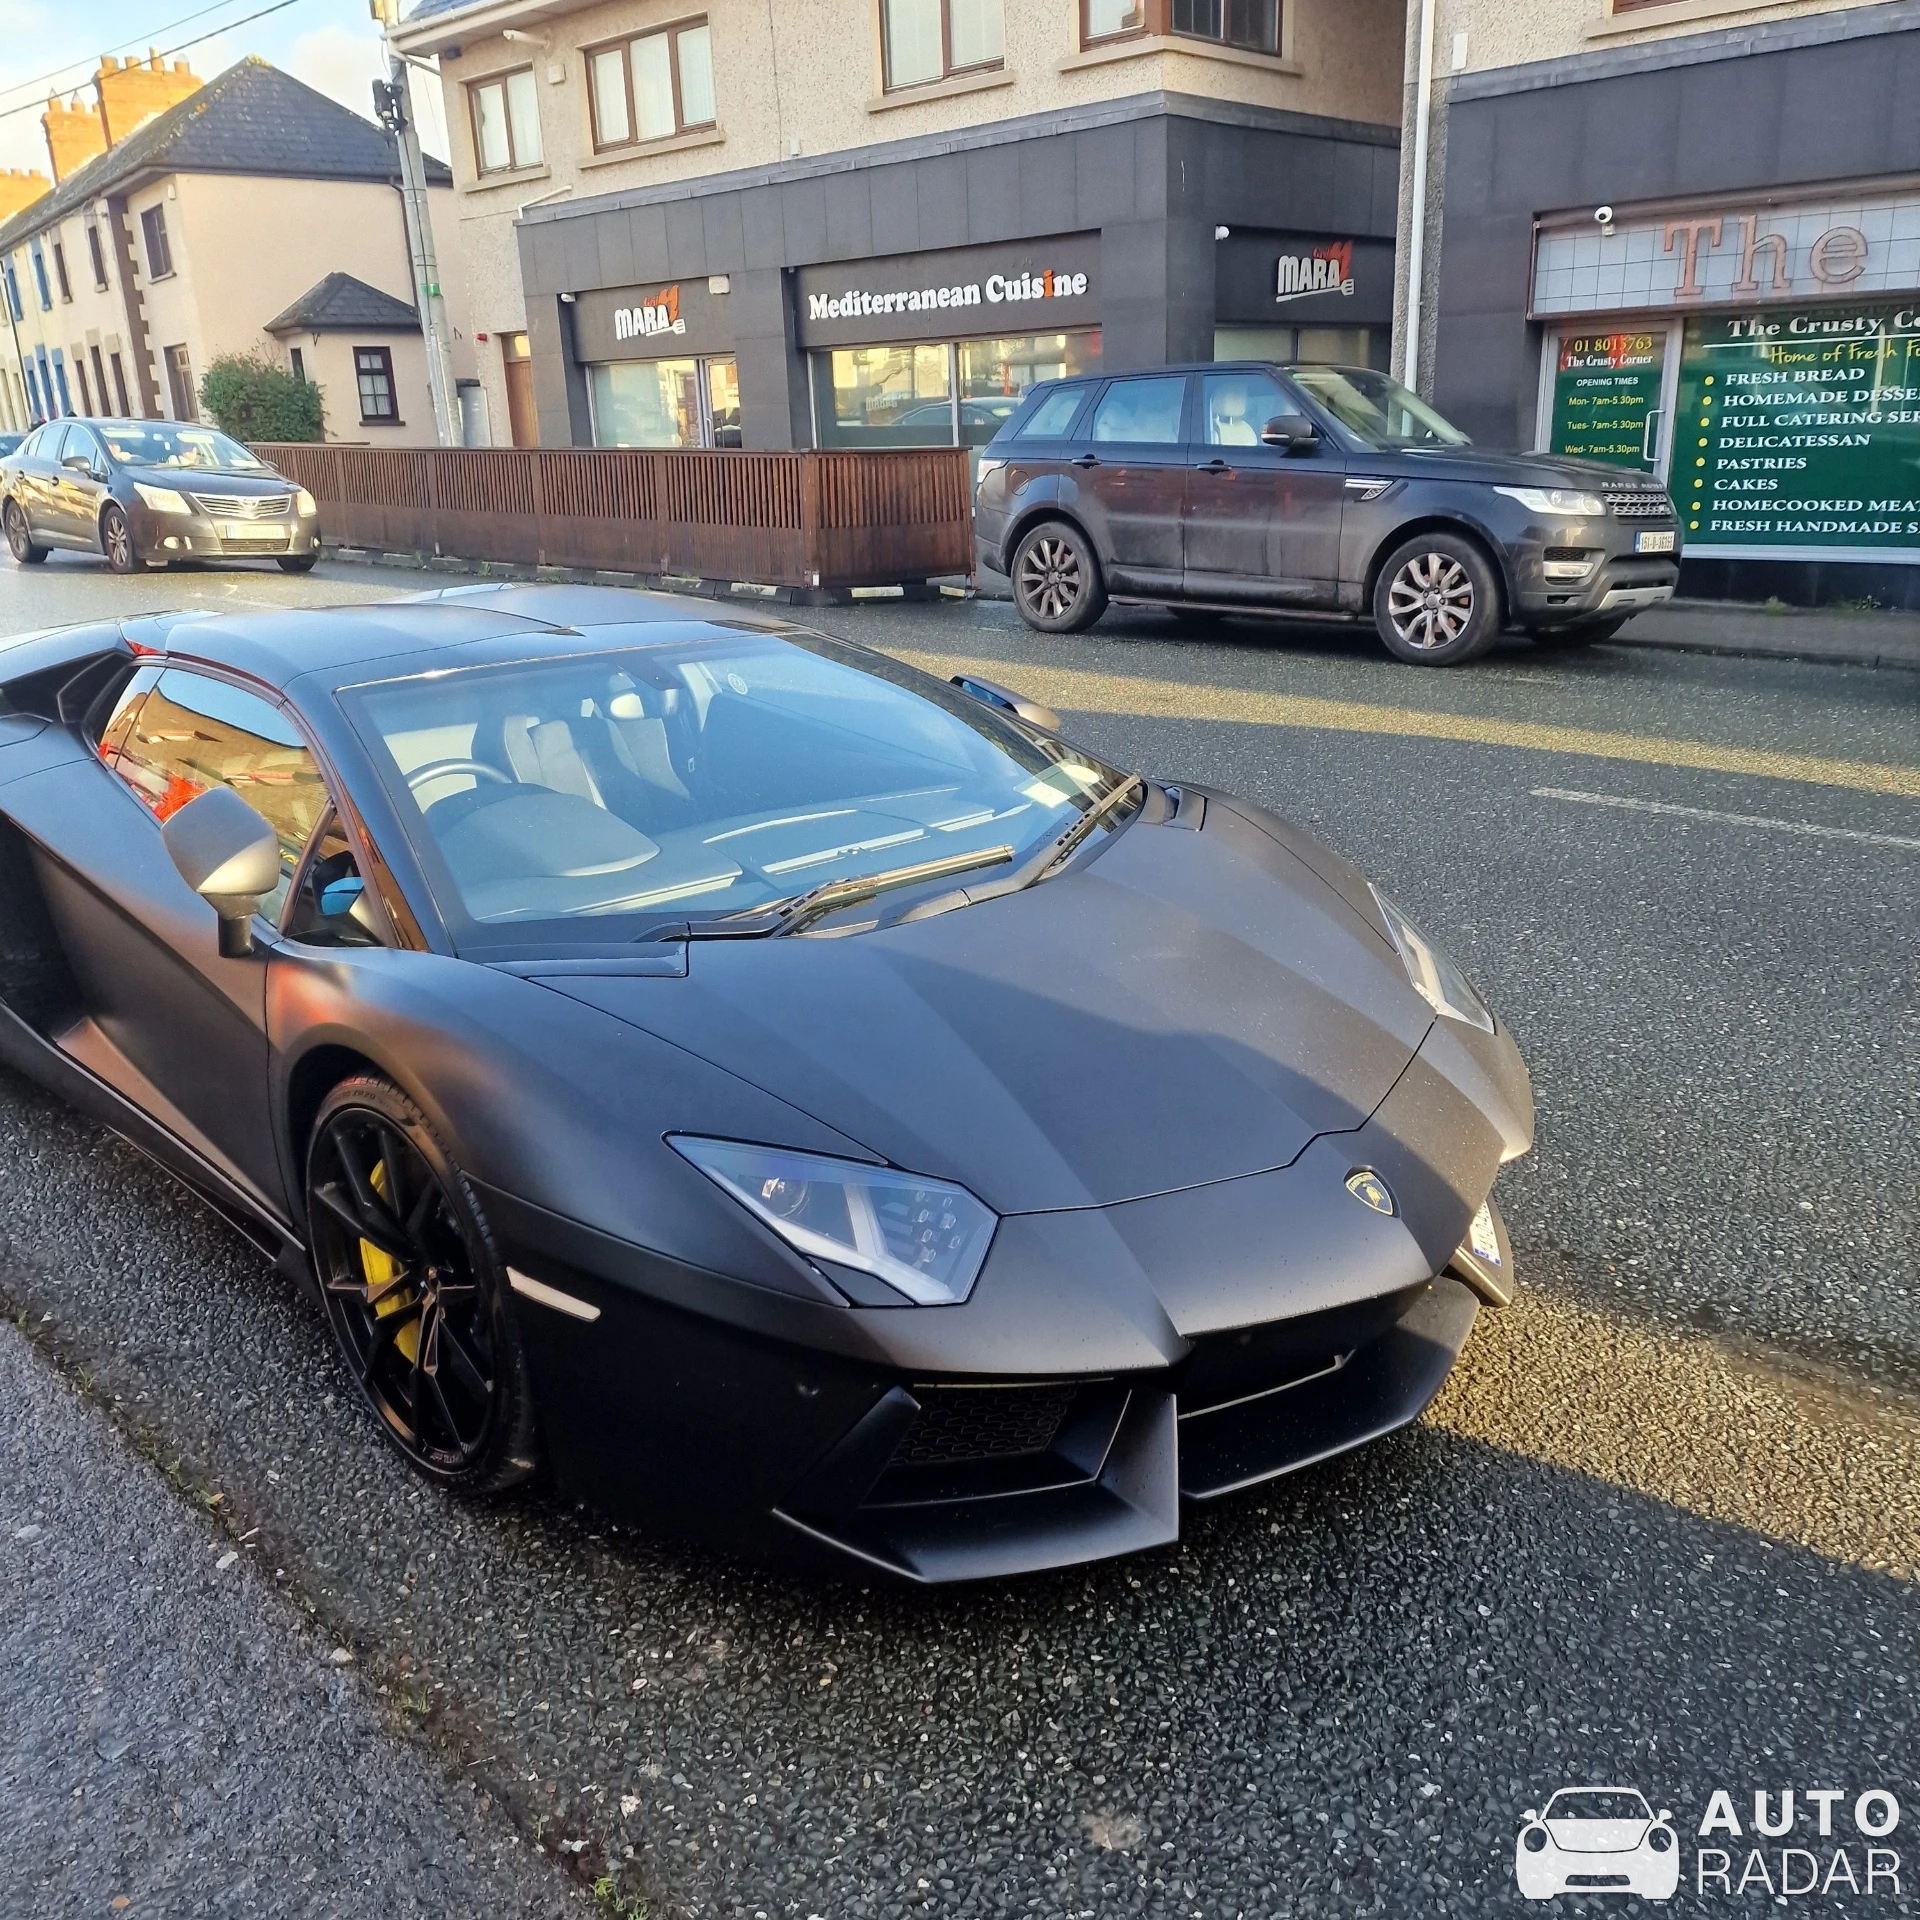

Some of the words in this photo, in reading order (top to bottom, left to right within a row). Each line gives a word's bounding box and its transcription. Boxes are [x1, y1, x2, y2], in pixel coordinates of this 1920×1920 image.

[1663, 214, 1868, 297] The
[1277, 255, 1340, 294] MARA
[808, 283, 982, 320] Mediterranean
[985, 269, 1088, 303] Cuisine
[614, 304, 670, 340] MARA
[1727, 319, 1781, 338] The
[1789, 316, 1885, 336] Crusty
[1574, 339, 1589, 352] 01
[1566, 355, 1584, 368] The
[1586, 354, 1618, 369] Crusty
[1620, 353, 1654, 365] Corner
[1769, 345, 1818, 365] Home
[1822, 343, 1847, 363] of
[1576, 378, 1612, 387] OPENING
[1614, 377, 1639, 385] TIMES
[1725, 371, 1788, 386] FRESH
[1793, 368, 1865, 383] BREAD
[1568, 397, 1589, 406] Mon-
[1723, 390, 1848, 407] HOMEMADE
[1853, 387, 1920, 402] DESSE
[1721, 415, 1770, 429] FULL
[1774, 411, 1883, 426] CATERING
[1565, 445, 1586, 454] Wed-
[1718, 434, 1872, 449] DELICATESSAN
[1716, 457, 1807, 470] PASTRIES
[1713, 478, 1779, 491] CAKES
[1711, 499, 1863, 512] HOMECOOKED
[1710, 520, 1771, 532] FRESH
[1775, 520, 1902, 534] HANDMADE
[1906, 521, 1920, 534] S
